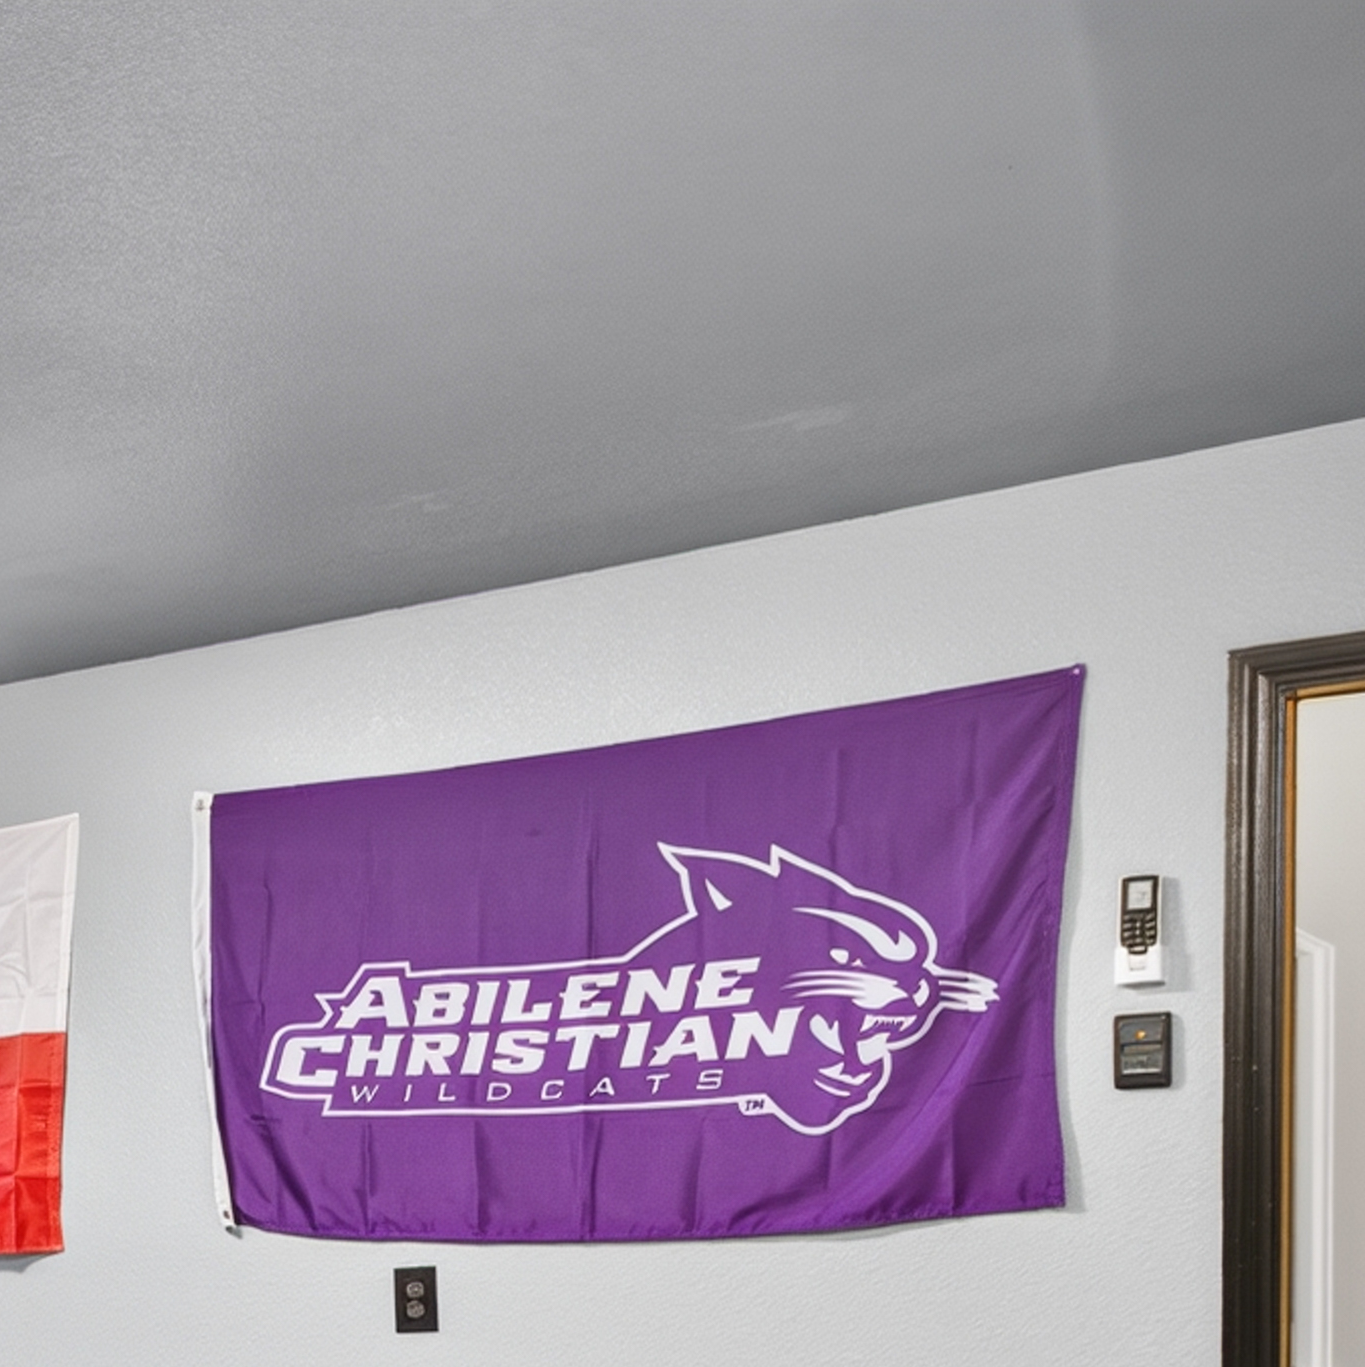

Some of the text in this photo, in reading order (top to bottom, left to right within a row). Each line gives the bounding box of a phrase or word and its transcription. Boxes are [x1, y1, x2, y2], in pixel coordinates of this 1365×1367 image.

[333, 956, 761, 1029] ABILENE
[275, 1005, 805, 1087] CHRISTIAN
[350, 1068, 724, 1103] WILDCATS
